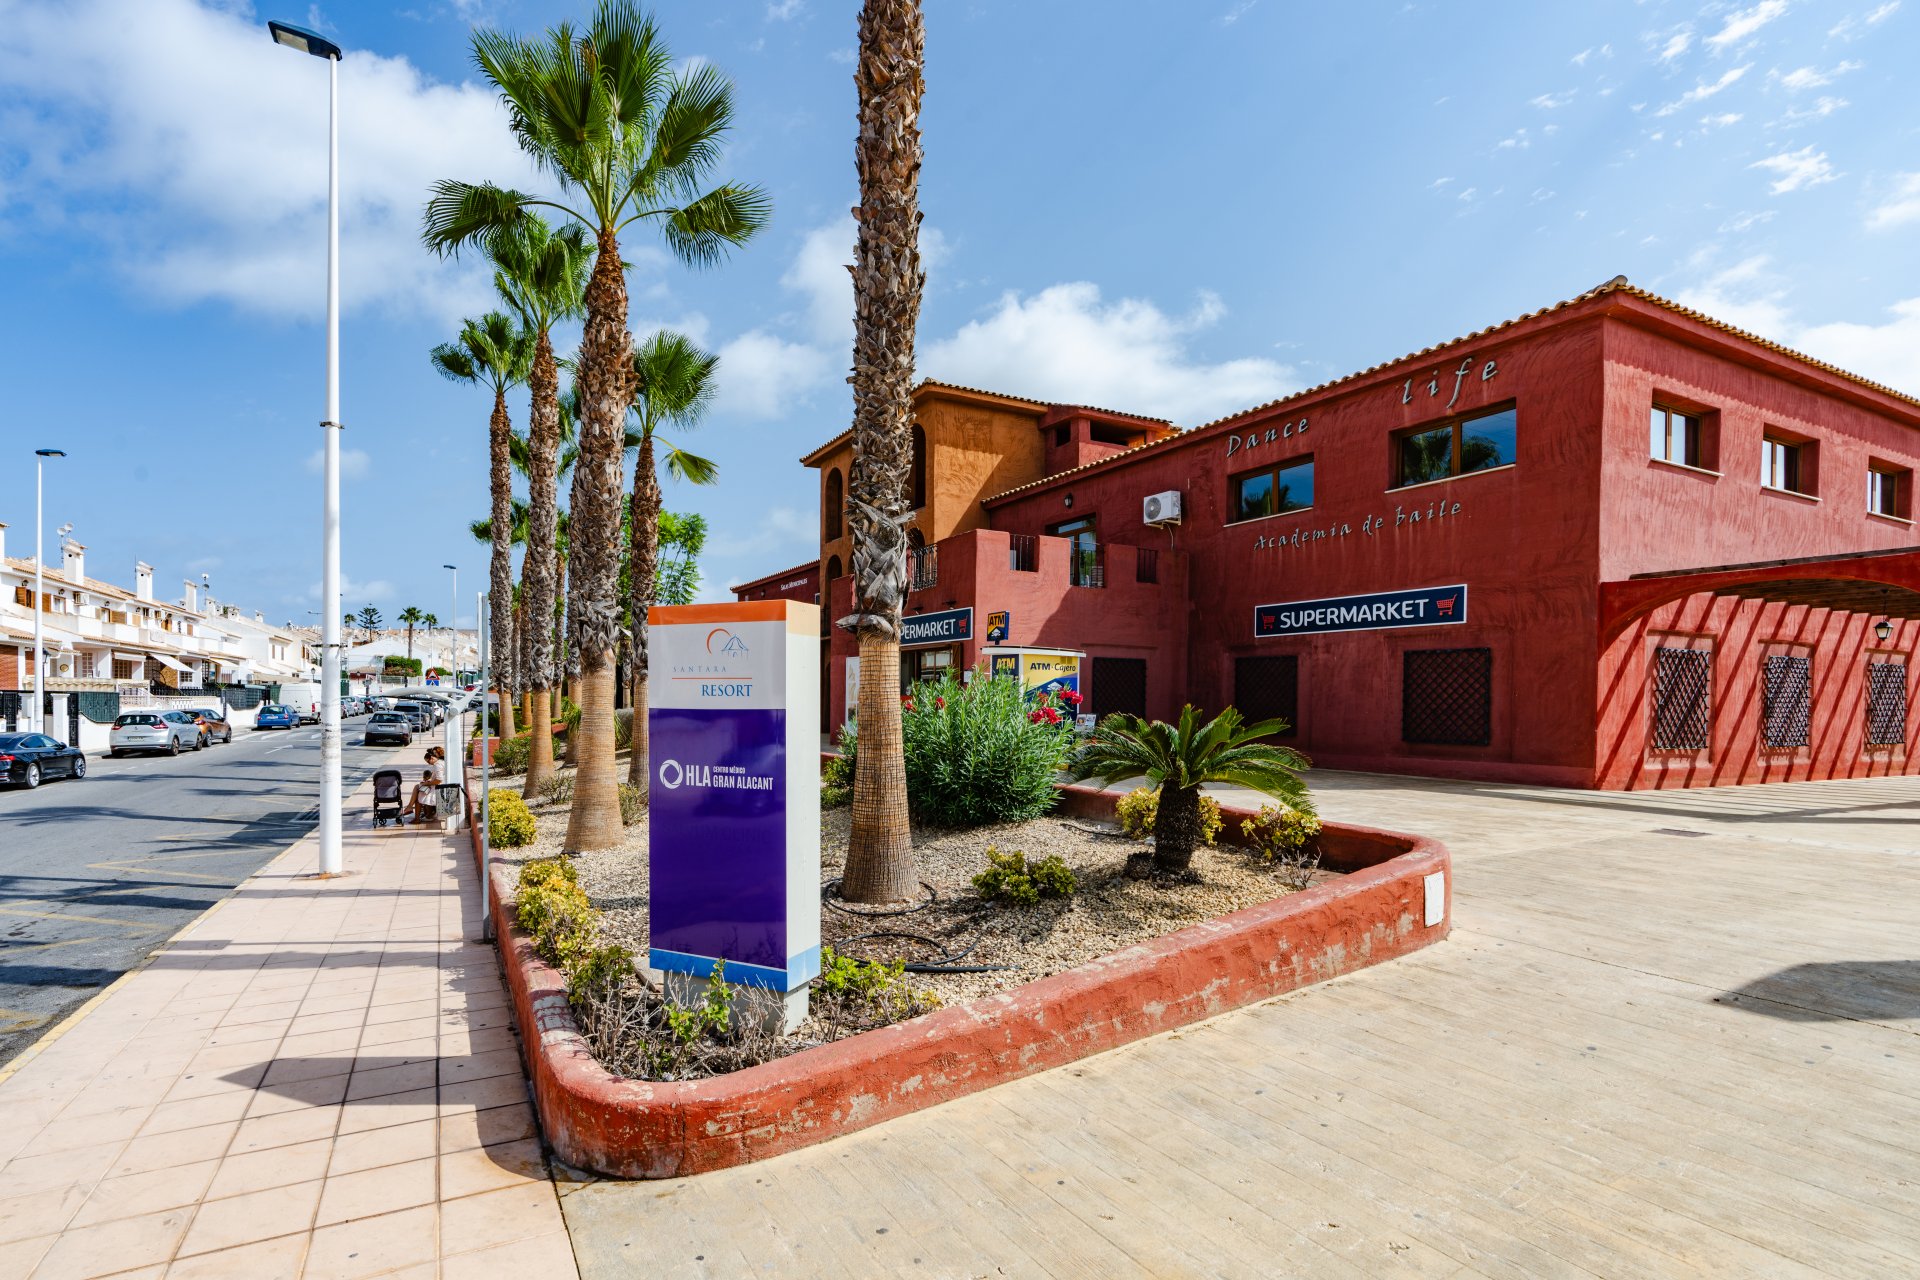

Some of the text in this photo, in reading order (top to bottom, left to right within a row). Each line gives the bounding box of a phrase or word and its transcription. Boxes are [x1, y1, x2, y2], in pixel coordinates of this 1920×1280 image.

[1226, 357, 1499, 457] Dance life
[1254, 499, 1462, 550] Academia de baile
[988, 614, 1005, 626] ATM
[1280, 599, 1429, 628] SUPERMARKET
[900, 618, 956, 640] PERMARKET
[996, 657, 1015, 670] ATM
[1030, 662, 1076, 673] ATM Cajero
[702, 684, 753, 697] RESORT
[685, 764, 712, 787] HLA
[713, 765, 746, 775] CENTRO MÉDICO
[713, 775, 774, 791] GRAN ALACANT
